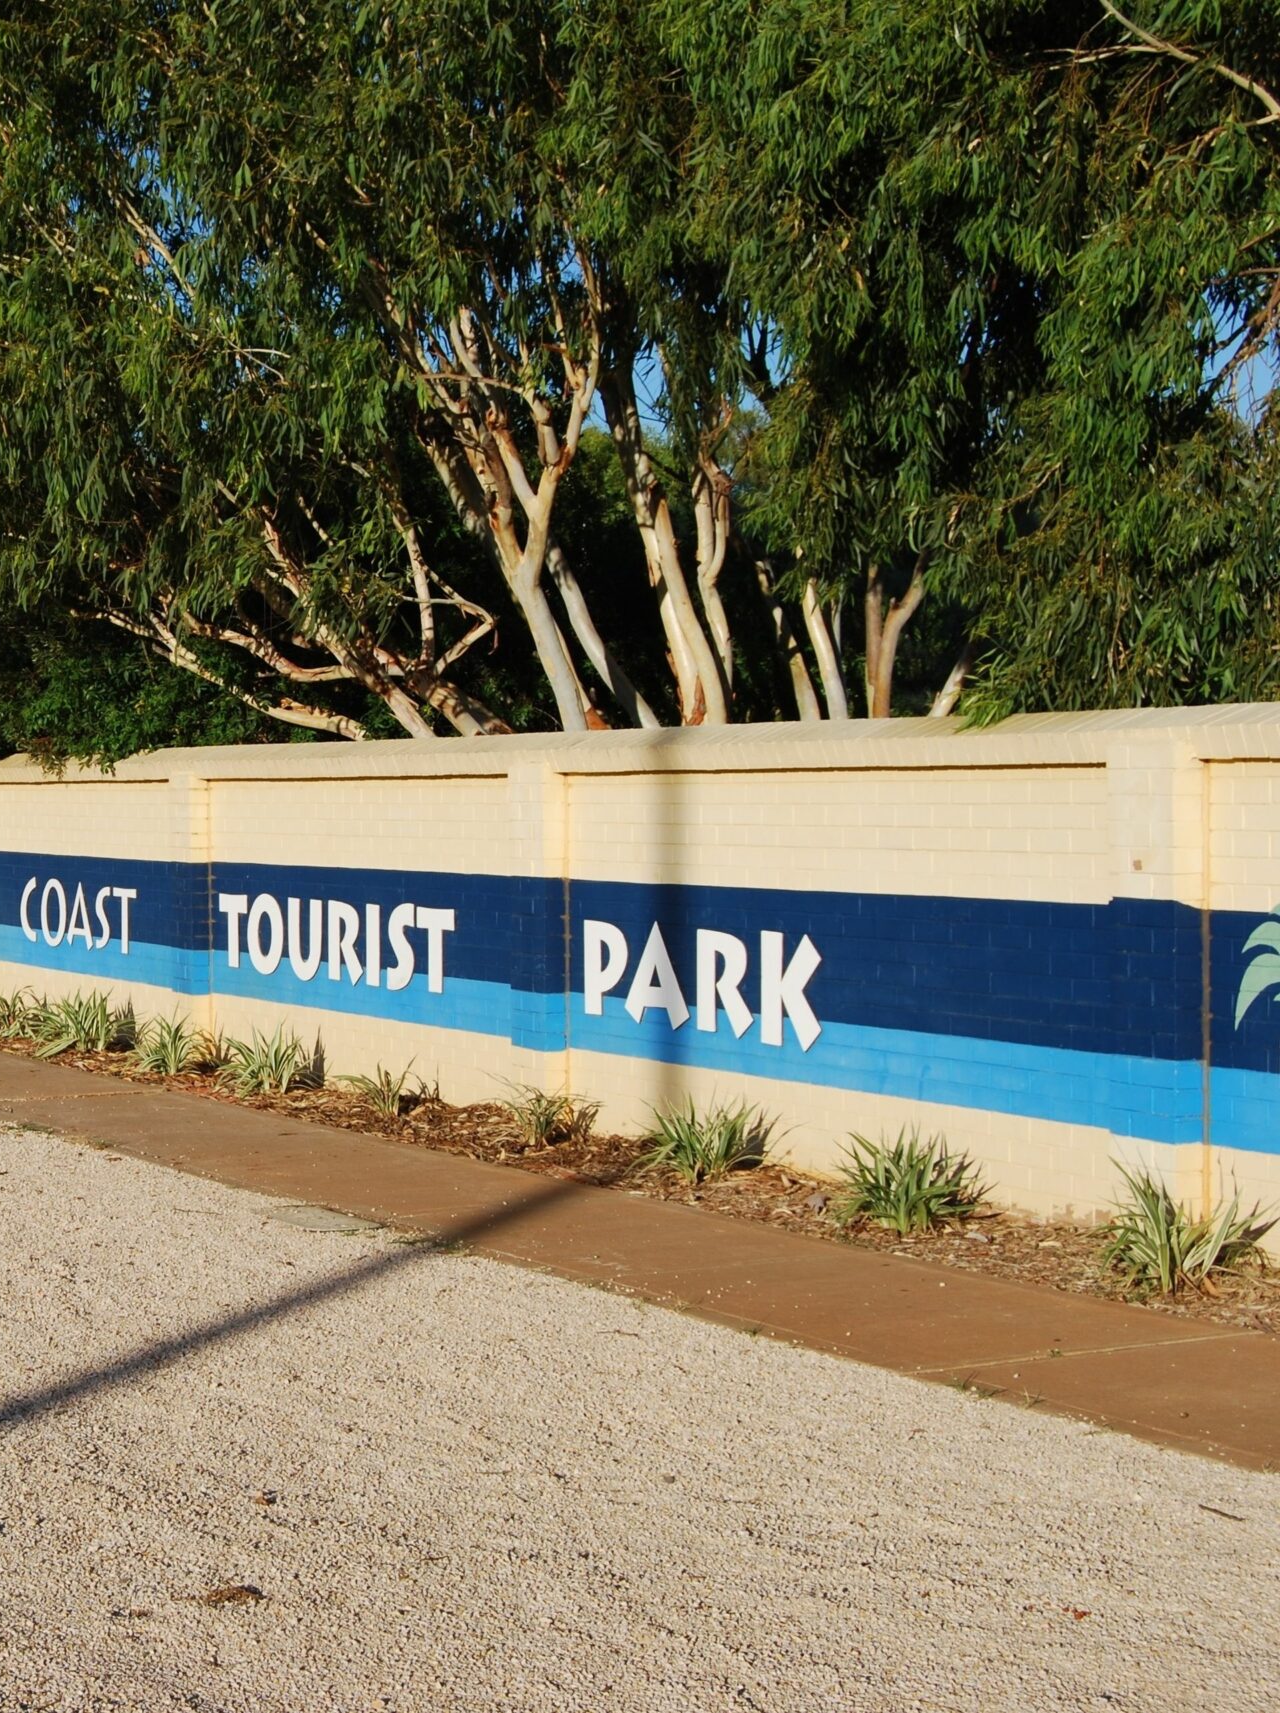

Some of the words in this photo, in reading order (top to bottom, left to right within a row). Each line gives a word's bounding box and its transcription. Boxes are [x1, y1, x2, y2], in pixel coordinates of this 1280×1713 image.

[20, 876, 137, 955] COAST
[218, 892, 455, 994] TOURIST
[583, 919, 822, 1052] PARK
